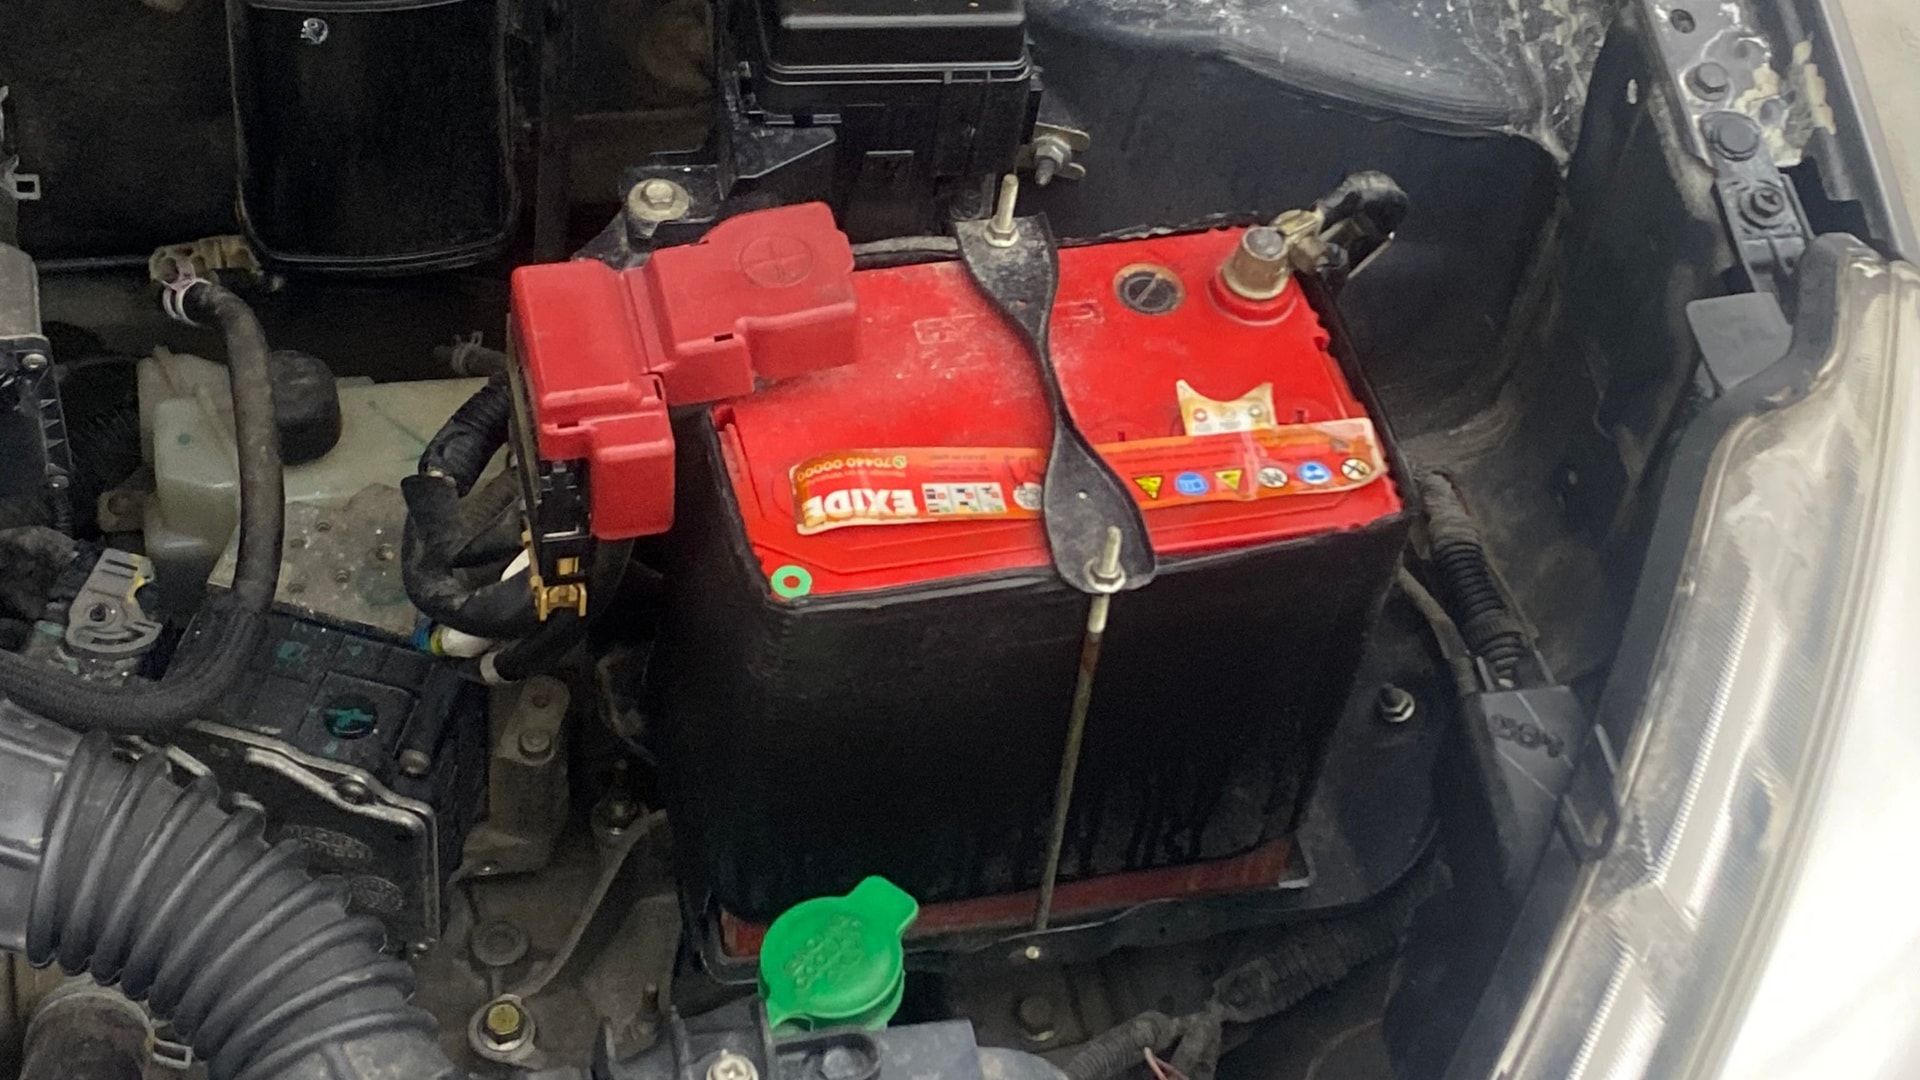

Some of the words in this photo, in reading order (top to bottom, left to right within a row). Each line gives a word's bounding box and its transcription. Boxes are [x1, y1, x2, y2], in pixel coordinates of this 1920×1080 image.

[797, 459, 843, 482] 00000
[846, 457, 892, 469] 70440
[802, 488, 918, 527] EXIDE
